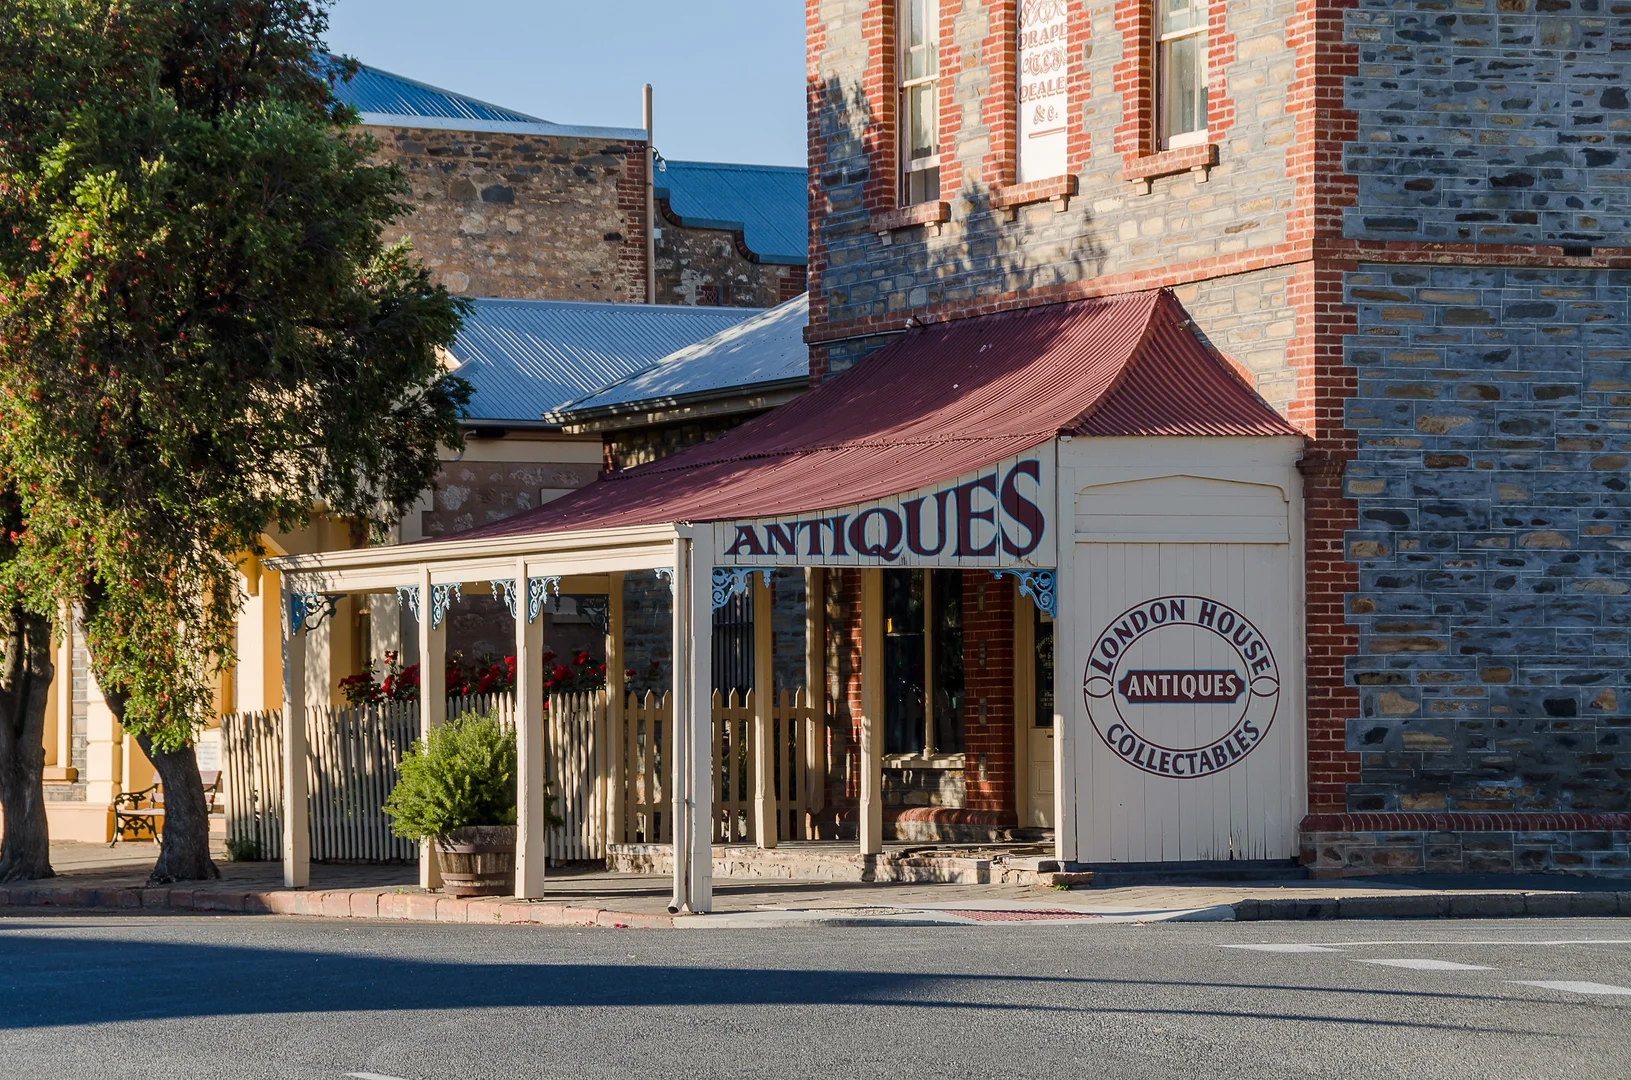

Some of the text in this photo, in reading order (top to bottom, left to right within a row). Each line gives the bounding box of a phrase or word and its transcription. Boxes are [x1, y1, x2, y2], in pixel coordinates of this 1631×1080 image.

[1019, 76, 1068, 104] DEALE
[723, 459, 1046, 562] ANTIQUES
[1090, 599, 1185, 676] LONDON
[1198, 601, 1272, 676] HOUSE
[1127, 674, 1237, 699] ANTIQUES
[1106, 719, 1260, 775] COLLECTABLES
